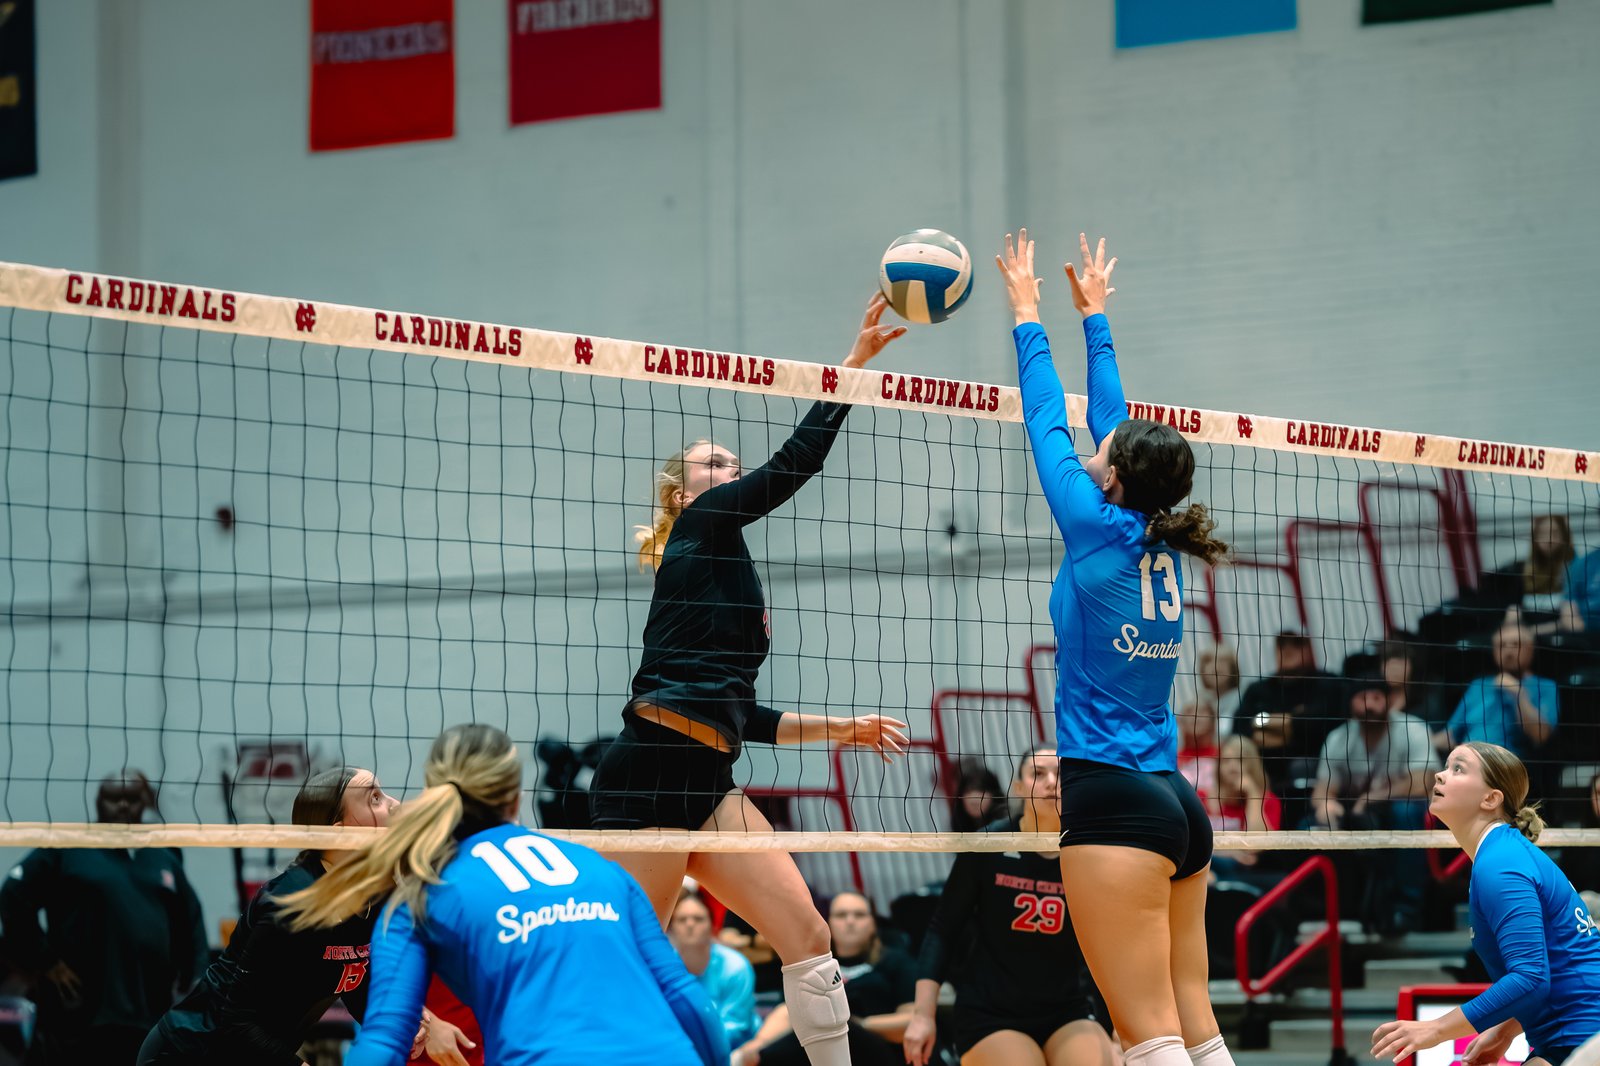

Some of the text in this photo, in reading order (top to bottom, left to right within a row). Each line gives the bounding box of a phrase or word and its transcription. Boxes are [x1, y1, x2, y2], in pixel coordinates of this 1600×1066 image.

[312, 20, 449, 64] PIONEERS
[66, 273, 236, 322] CARDINALS
[375, 311, 522, 357] CARDINALS
[644, 344, 775, 386] CARDINALS
[881, 373, 1000, 412] CARDINALS
[1126, 402, 1201, 434] DINALS
[1286, 420, 1382, 454] CARDINALS
[1457, 440, 1546, 470] CARDINALS
[1138, 552, 1182, 622] 13
[1112, 623, 1181, 662] Sparta
[470, 834, 580, 893] 10
[496, 897, 620, 944] Spartans
[1011, 892, 1066, 935] 29
[333, 958, 370, 994] 15
